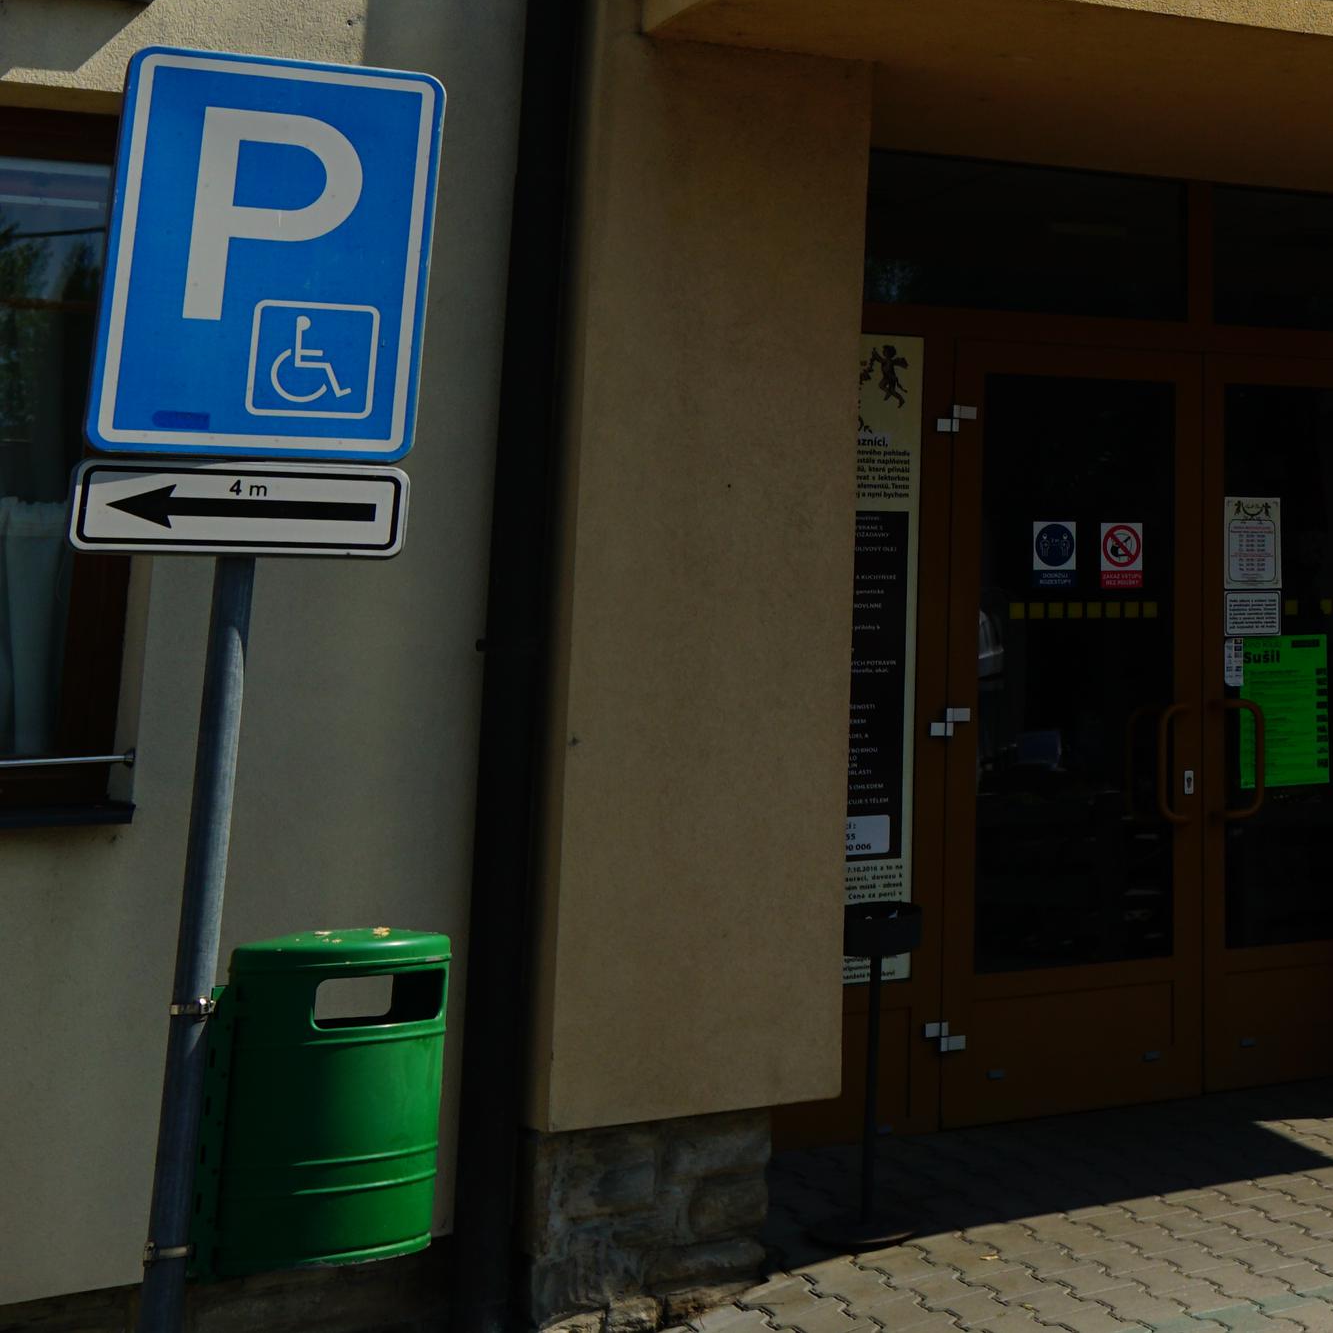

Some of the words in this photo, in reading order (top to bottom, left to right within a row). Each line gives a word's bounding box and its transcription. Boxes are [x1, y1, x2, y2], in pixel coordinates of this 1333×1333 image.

[181, 106, 364, 321] P
[229, 478, 243, 496] 4
[249, 483, 268, 498] m
[1243, 650, 1280, 664] Sušil
[855, 843, 871, 851] 006
